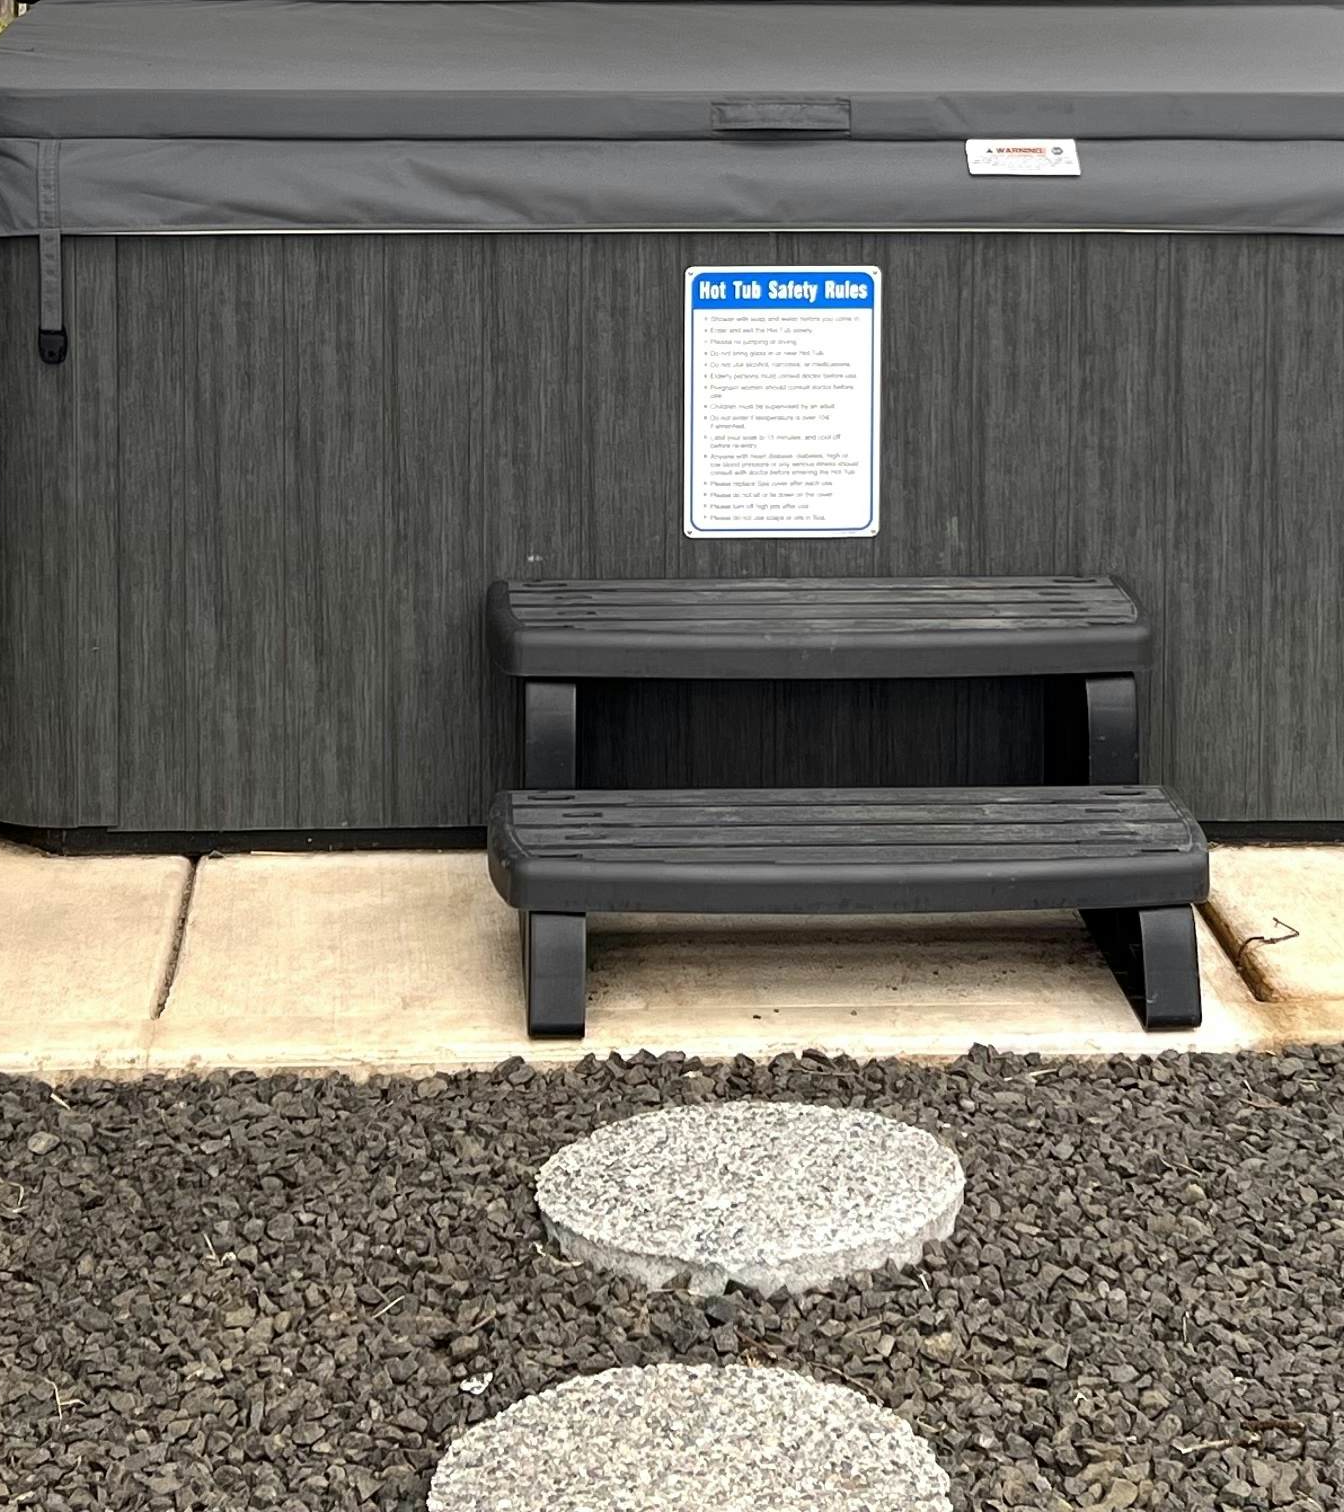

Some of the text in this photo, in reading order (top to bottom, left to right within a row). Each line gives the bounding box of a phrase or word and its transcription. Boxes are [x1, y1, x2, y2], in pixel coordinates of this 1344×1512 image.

[699, 280, 868, 303] Hot Tub Safety Rules
